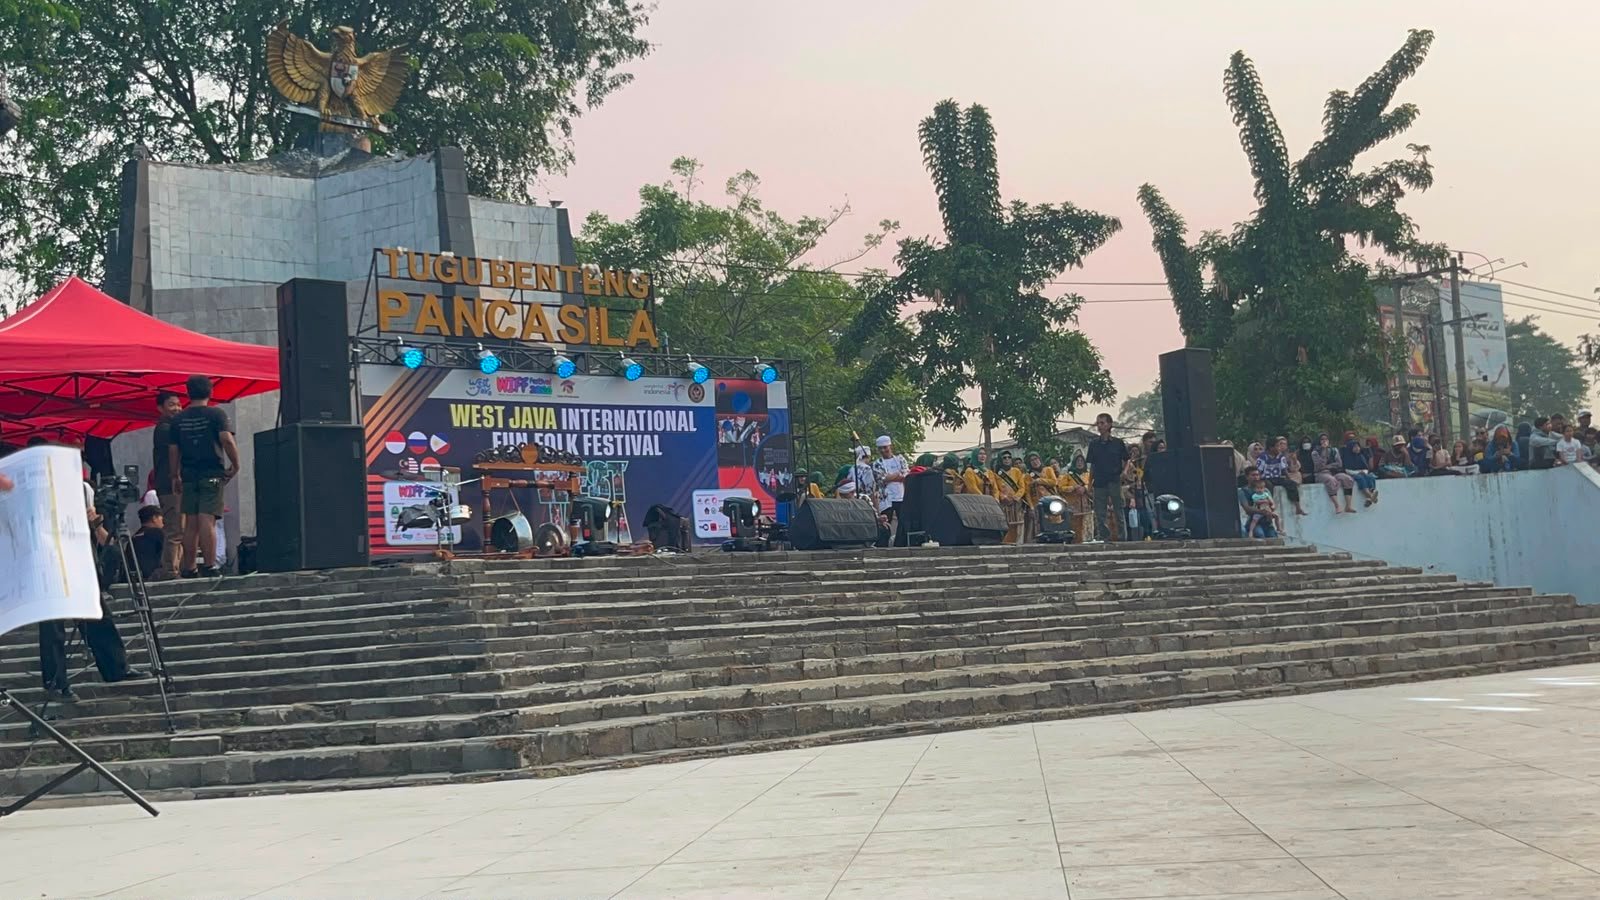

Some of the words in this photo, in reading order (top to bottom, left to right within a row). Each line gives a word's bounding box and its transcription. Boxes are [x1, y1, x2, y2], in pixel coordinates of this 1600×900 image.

[381, 248, 484, 287] TUGU
[489, 259, 650, 299] BENTENG
[378, 289, 659, 347] PANCASILA
[450, 404, 505, 428] WEST
[509, 407, 558, 430] JAVA
[561, 408, 697, 432] INTERNATIONAL
[492, 431, 529, 450] FUN
[583, 433, 663, 456] FESTIVAL
